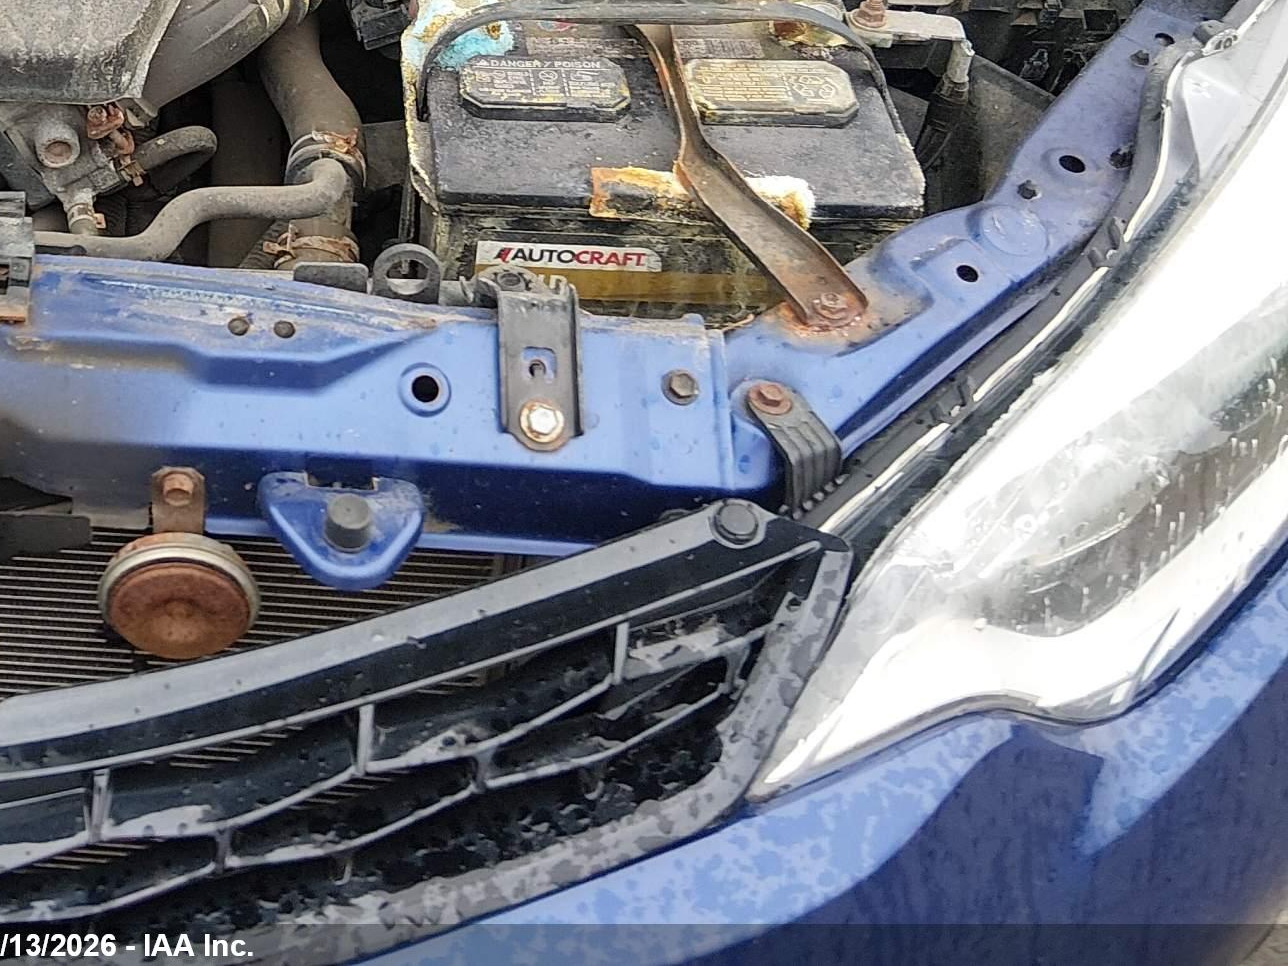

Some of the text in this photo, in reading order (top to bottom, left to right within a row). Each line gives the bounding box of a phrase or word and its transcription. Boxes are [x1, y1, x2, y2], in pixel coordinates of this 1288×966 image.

[490, 59, 542, 68] DANGER
[554, 60, 601, 69] POISON
[511, 247, 647, 267] AUTOCRAFT
